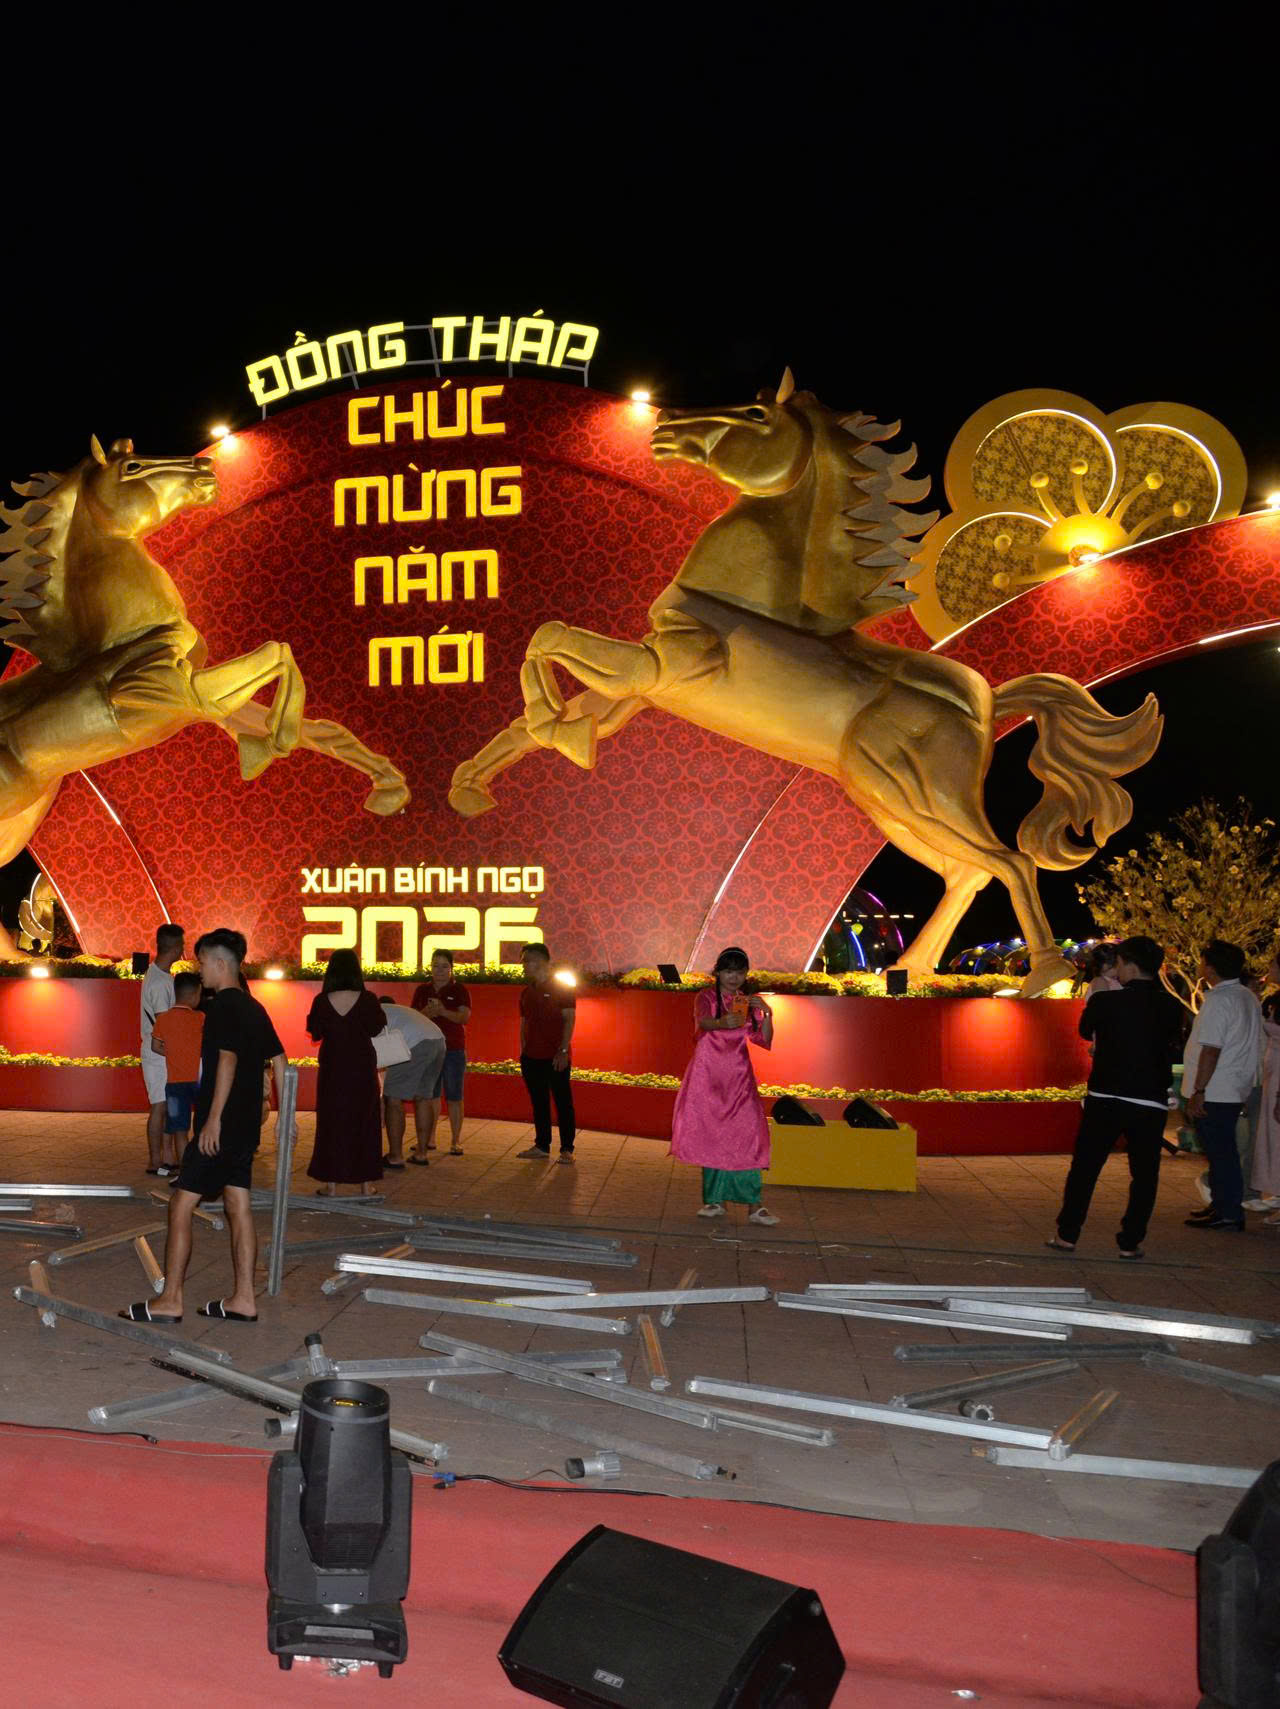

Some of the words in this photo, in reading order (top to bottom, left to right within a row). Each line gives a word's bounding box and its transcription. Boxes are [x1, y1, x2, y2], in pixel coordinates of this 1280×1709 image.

[246, 321, 408, 407] ĐỒNG
[431, 308, 601, 368] THÁP
[346, 380, 507, 446] CHÚC
[333, 462, 523, 528] MỪNG
[353, 545, 500, 606] NĂM
[368, 624, 486, 688] MỚI
[300, 862, 387, 893] XUÂN
[393, 862, 469, 893] BÍNH
[477, 866, 545, 900] NGỌ
[300, 906, 544, 973] 2026
